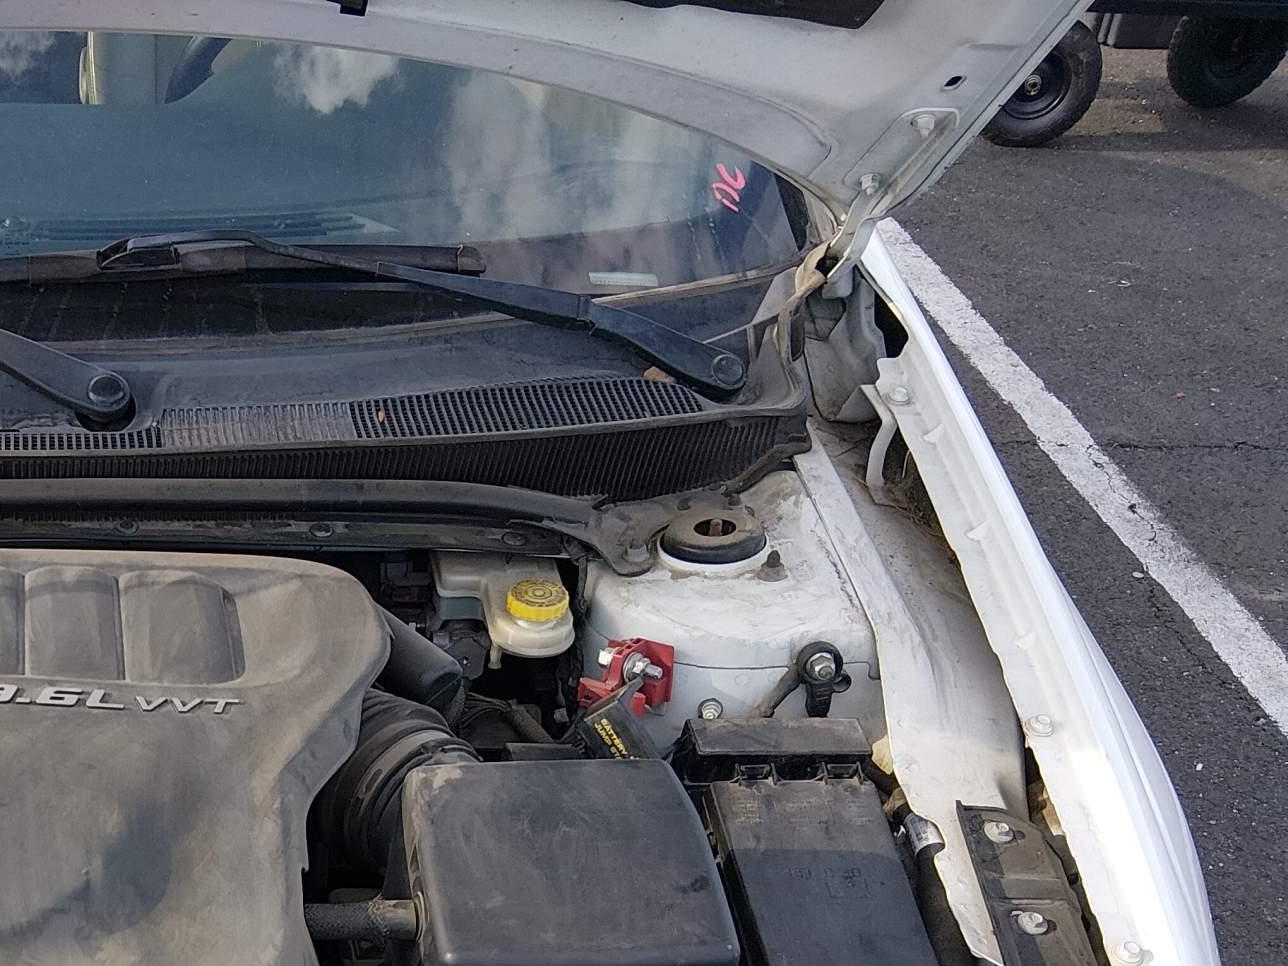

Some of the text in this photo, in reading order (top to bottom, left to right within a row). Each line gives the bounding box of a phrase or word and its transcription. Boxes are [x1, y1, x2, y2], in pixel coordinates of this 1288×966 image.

[135, 695, 240, 714] VVT
[594, 722, 612, 746] JUMP
[600, 718, 628, 755] BATTERY
